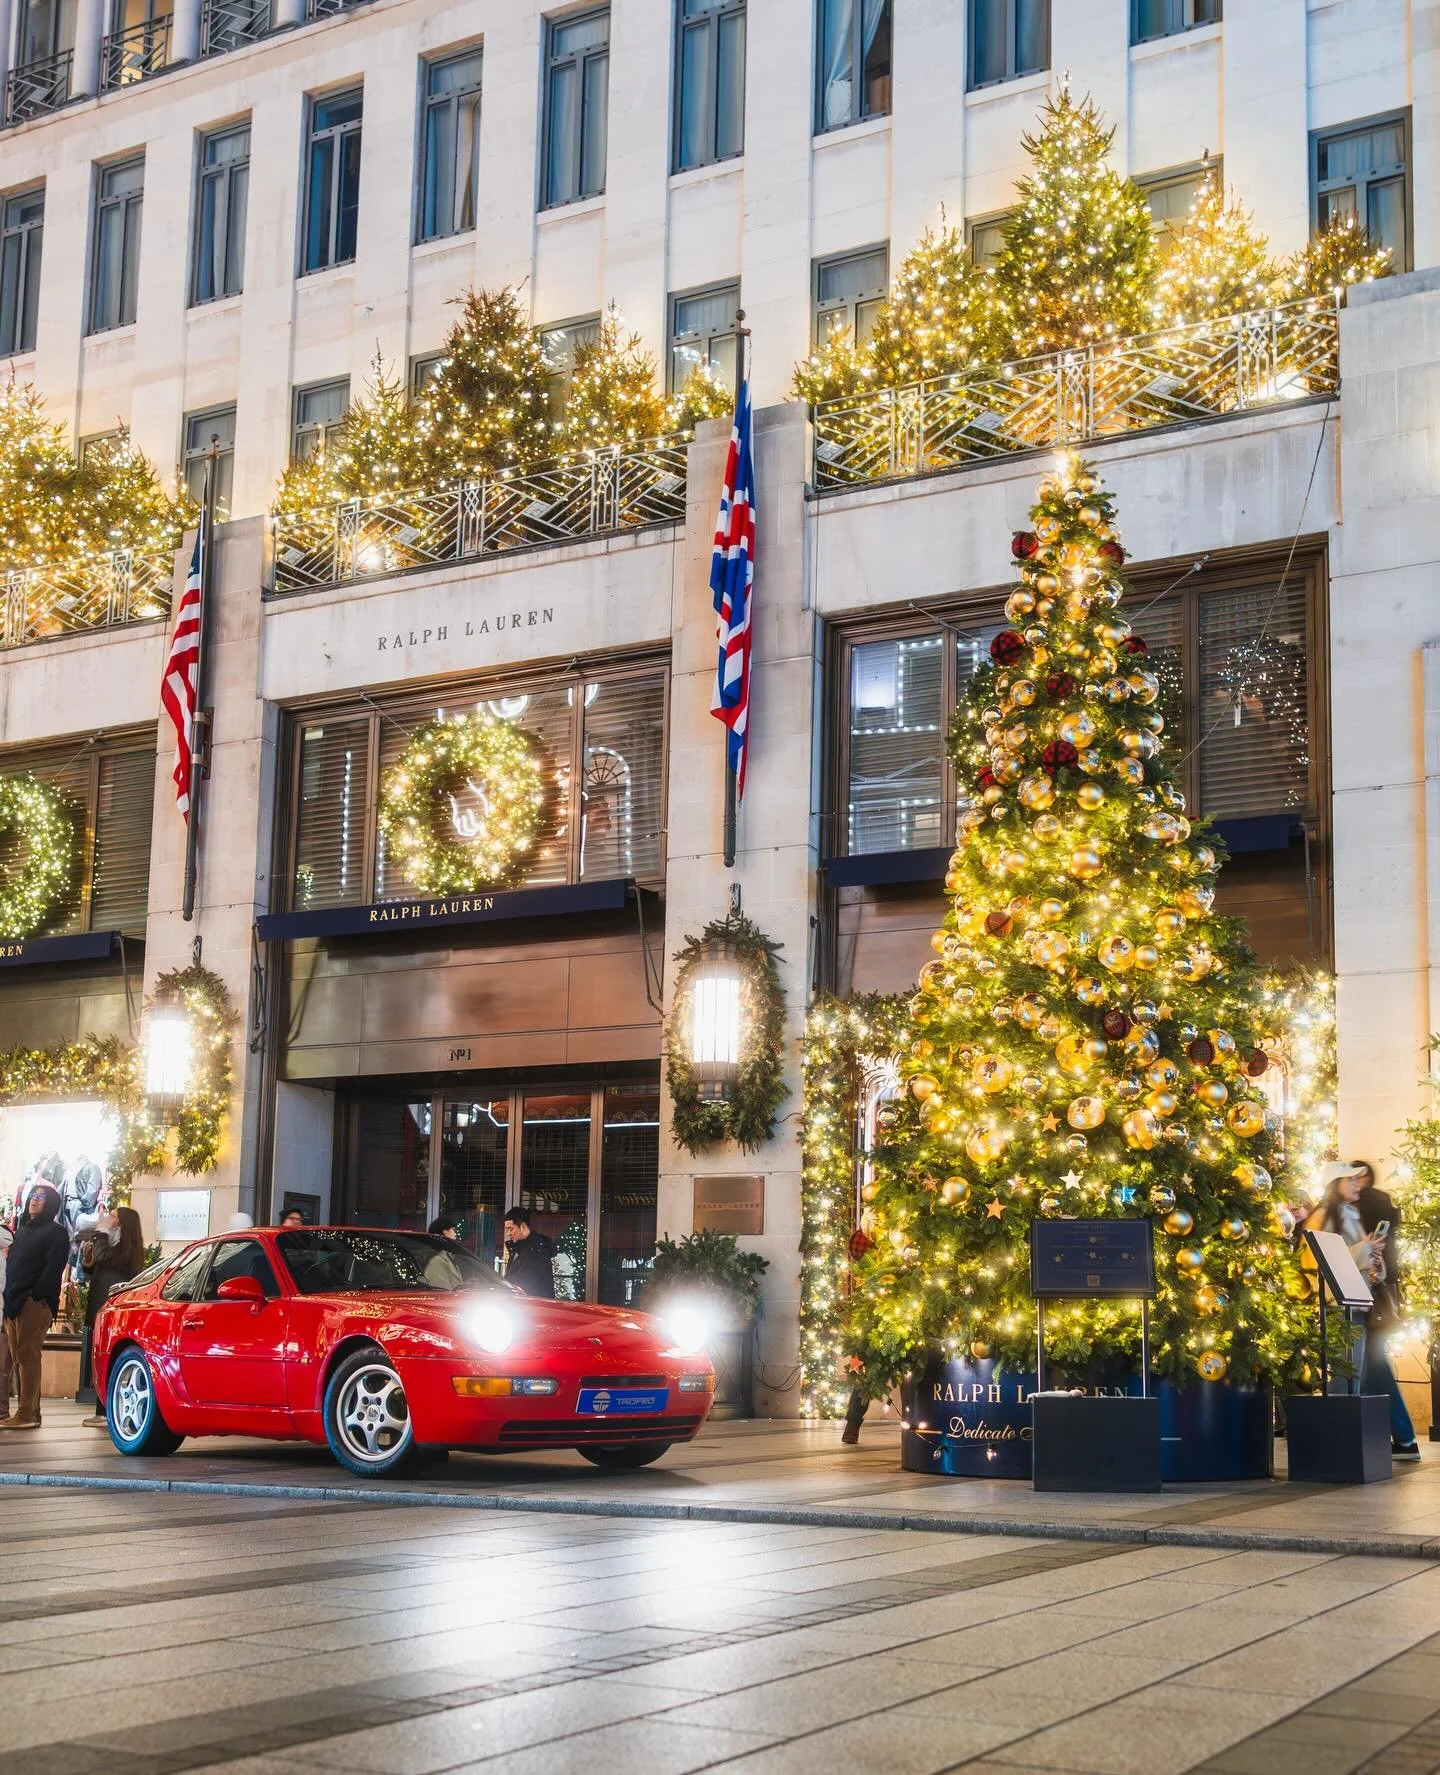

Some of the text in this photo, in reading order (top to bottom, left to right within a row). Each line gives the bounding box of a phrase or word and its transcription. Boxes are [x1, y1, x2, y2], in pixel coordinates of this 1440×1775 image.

[377, 608, 554, 651] RALPH LAUREN
[369, 898, 494, 922] RALPH LAUREN
[933, 1383, 1002, 1403] RALPH
[946, 1416, 1016, 1440] Dedicate
